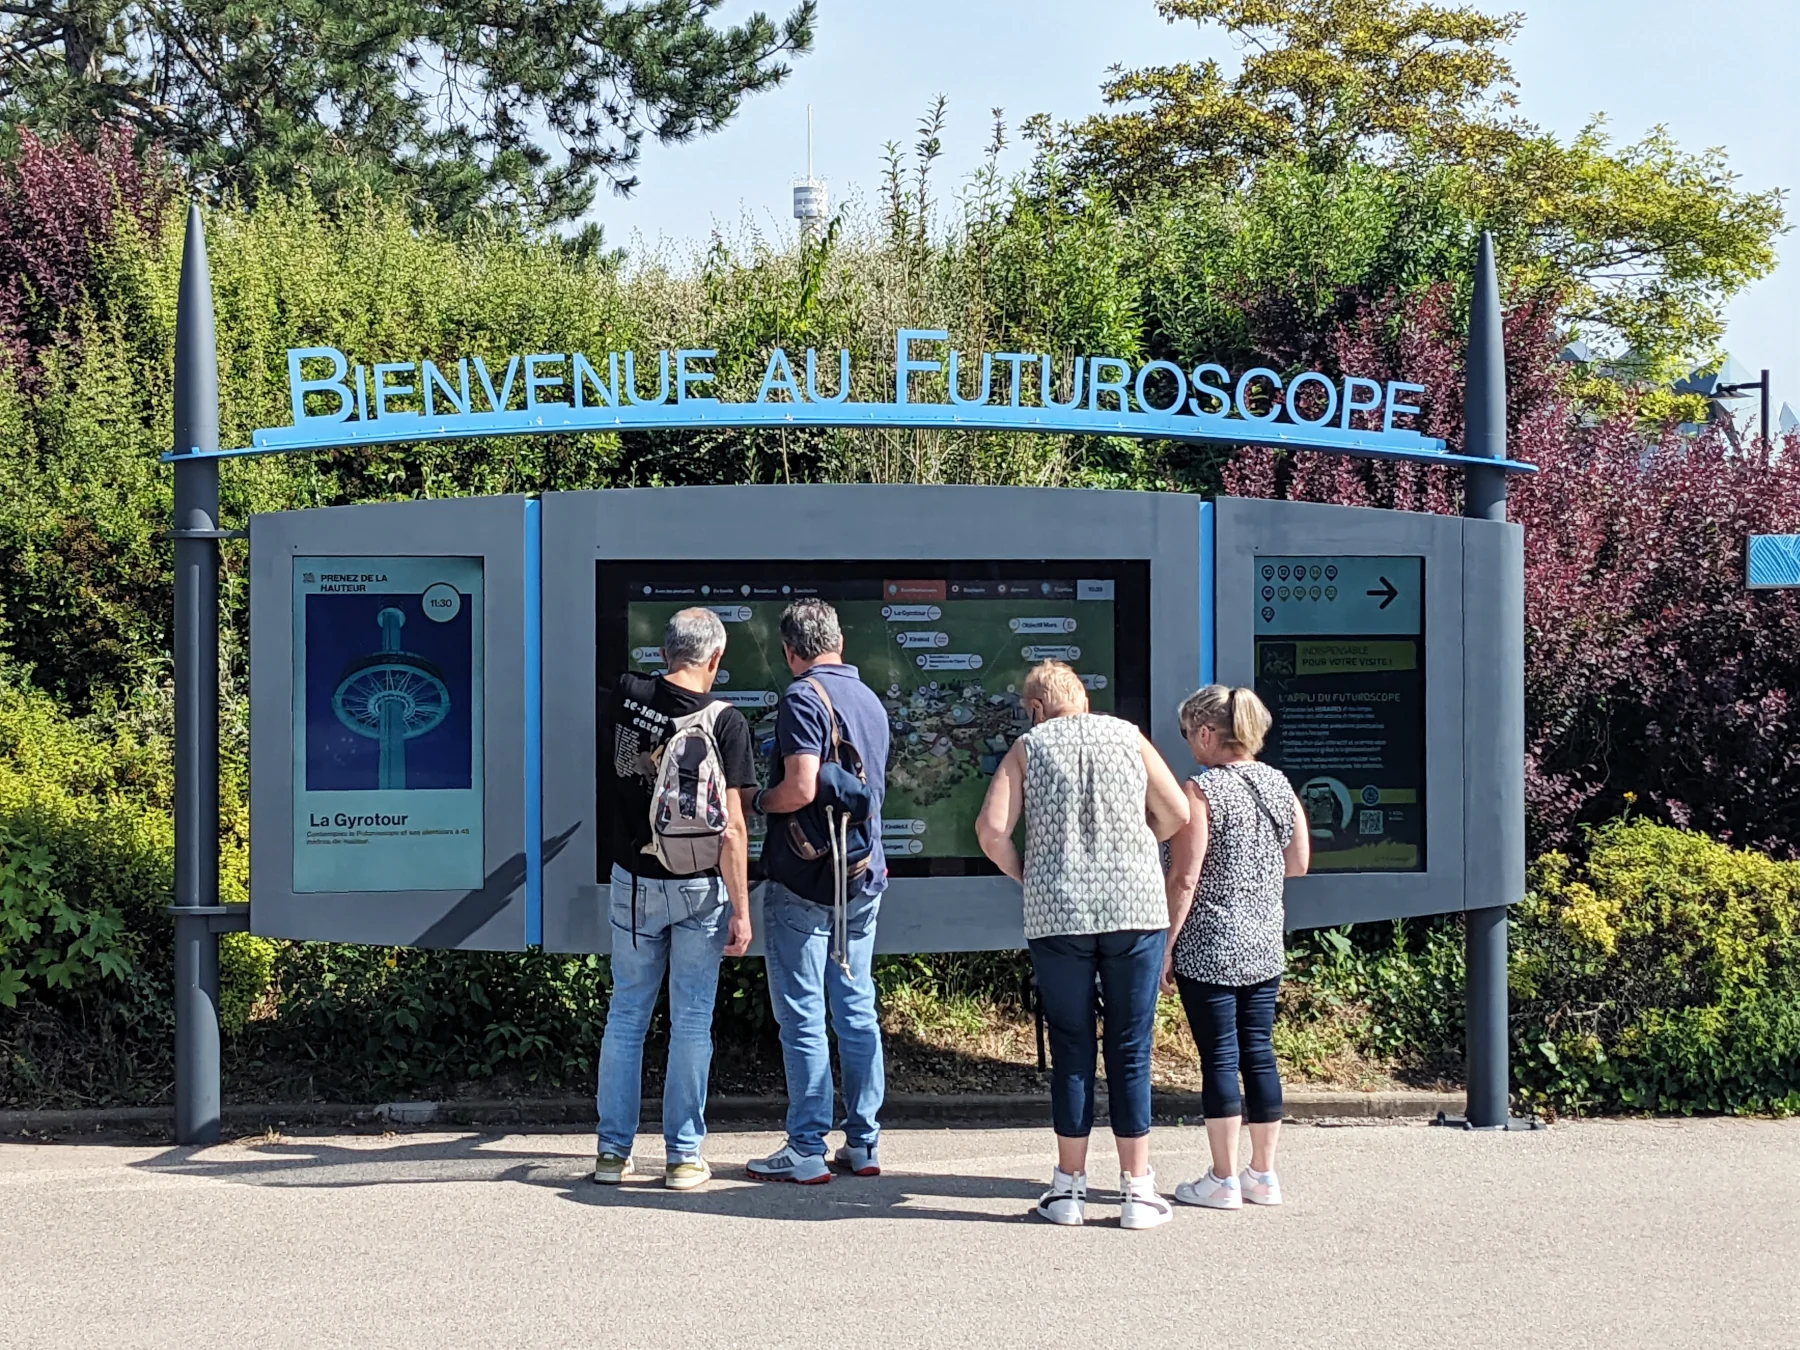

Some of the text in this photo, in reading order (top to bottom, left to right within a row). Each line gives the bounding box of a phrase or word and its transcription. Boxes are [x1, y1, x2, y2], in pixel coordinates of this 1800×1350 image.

[287, 328, 1426, 433] BIENVENUE AU FUTUROSCOPE
[320, 574, 388, 583] PRENEZ DE LA
[320, 584, 366, 592] HAUTEUR
[430, 599, 452, 608] 11:30
[1302, 646, 1369, 656] INDISPENSABLE
[1302, 657, 1327, 667] POUR
[1330, 657, 1358, 666] VOTRE
[1360, 657, 1387, 666] VISITE
[1278, 692, 1401, 702] L'APPLI DU FUTUROSCOPE
[310, 812, 408, 829] La Gyrotour
